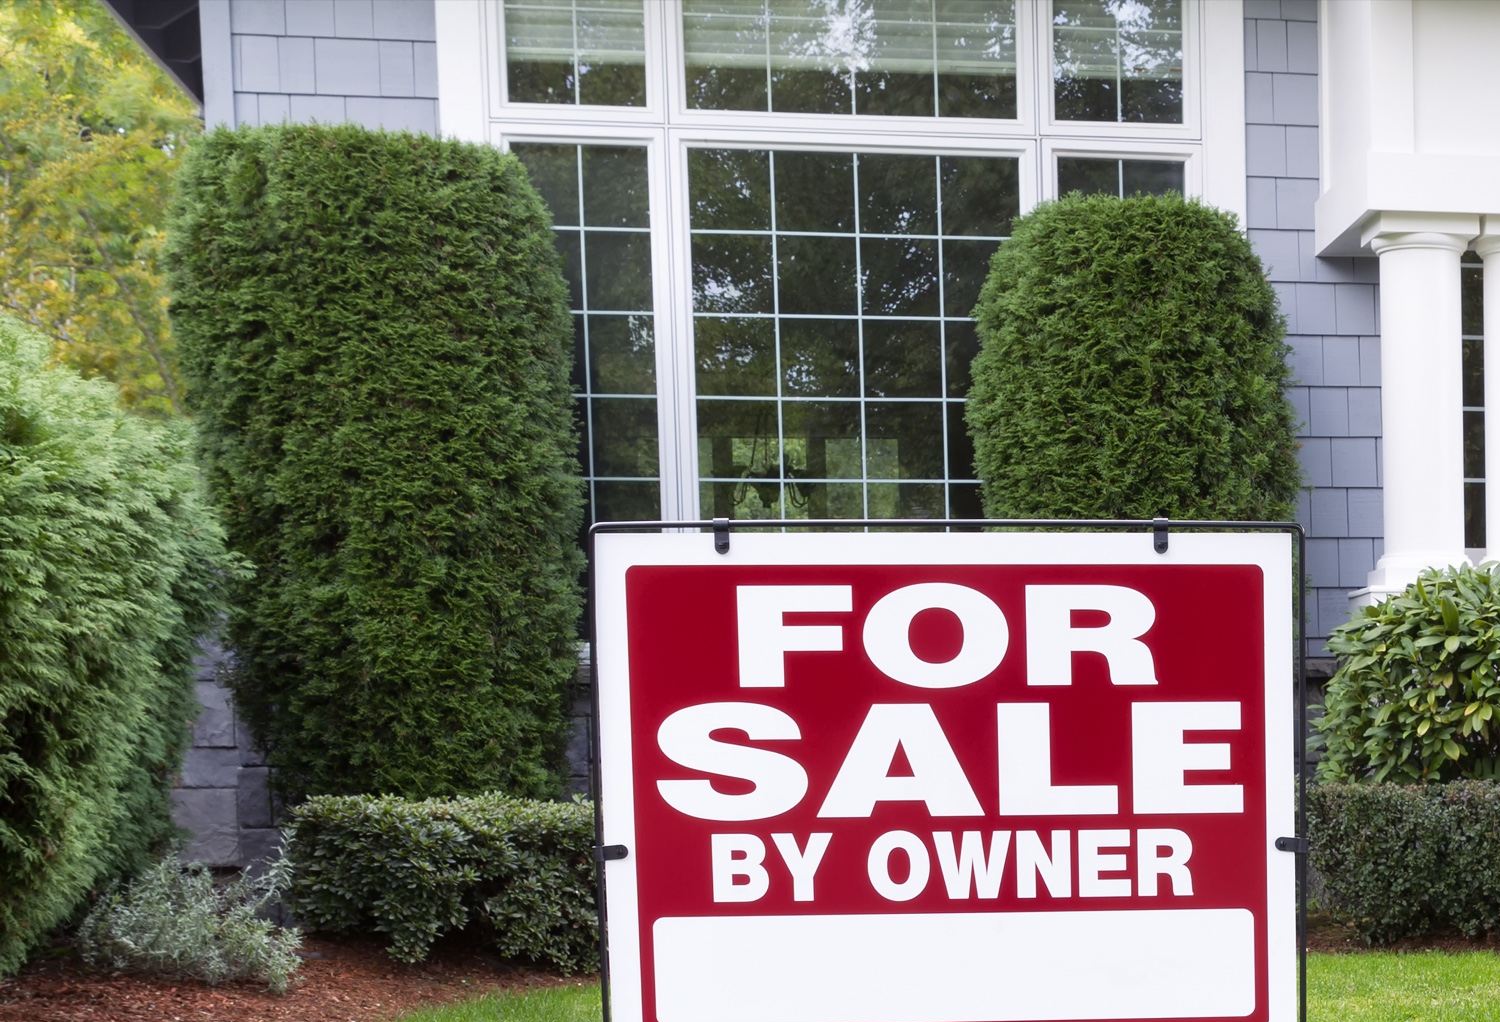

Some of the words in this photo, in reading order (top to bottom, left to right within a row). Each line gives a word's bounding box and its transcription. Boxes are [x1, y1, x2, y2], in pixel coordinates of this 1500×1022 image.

[736, 583, 1158, 688] FOR
[656, 701, 1244, 821] SALE
[711, 833, 833, 902] BY
[868, 829, 1194, 901] OWNER
